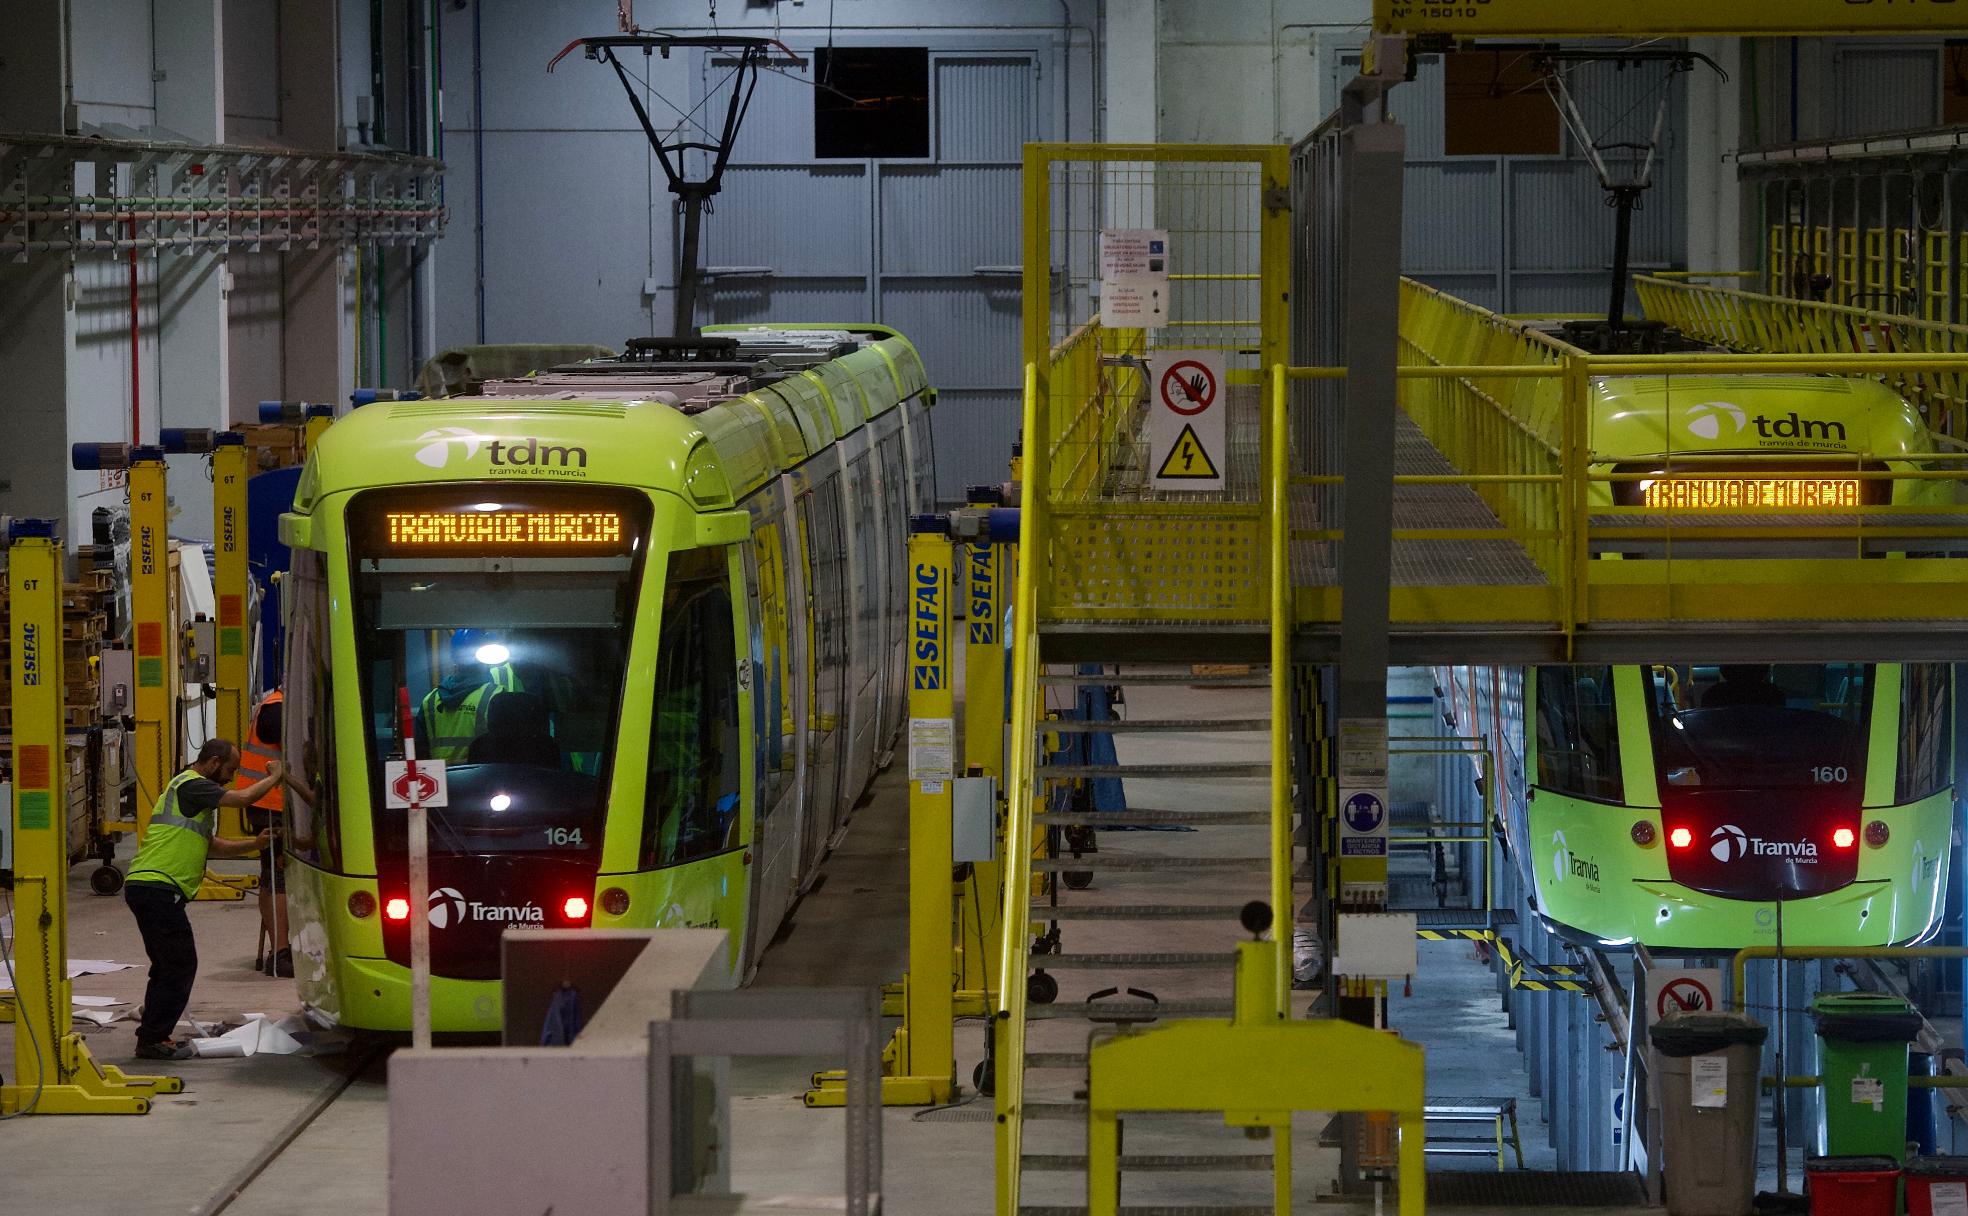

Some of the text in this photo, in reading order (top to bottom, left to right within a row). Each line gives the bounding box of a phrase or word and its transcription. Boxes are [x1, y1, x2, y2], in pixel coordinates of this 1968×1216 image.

[1420, 7, 1477, 18] 15010
[1752, 412, 1846, 441] tdm
[486, 438, 587, 467] tdm
[224, 475, 235, 484] 6T
[548, 469, 587, 478] murcia
[141, 492, 152, 501] 6T
[141, 526, 152, 564] SEFAC
[24, 580, 38, 590] 6T
[916, 564, 938, 662] SEFAC
[24, 622, 36, 672] SEFAC
[1810, 766, 1848, 784] 160
[544, 827, 583, 846] 164
[1750, 838, 1818, 856] Tranvía
[1569, 851, 1600, 882] Tranvía
[469, 900, 544, 920] Tranvía
